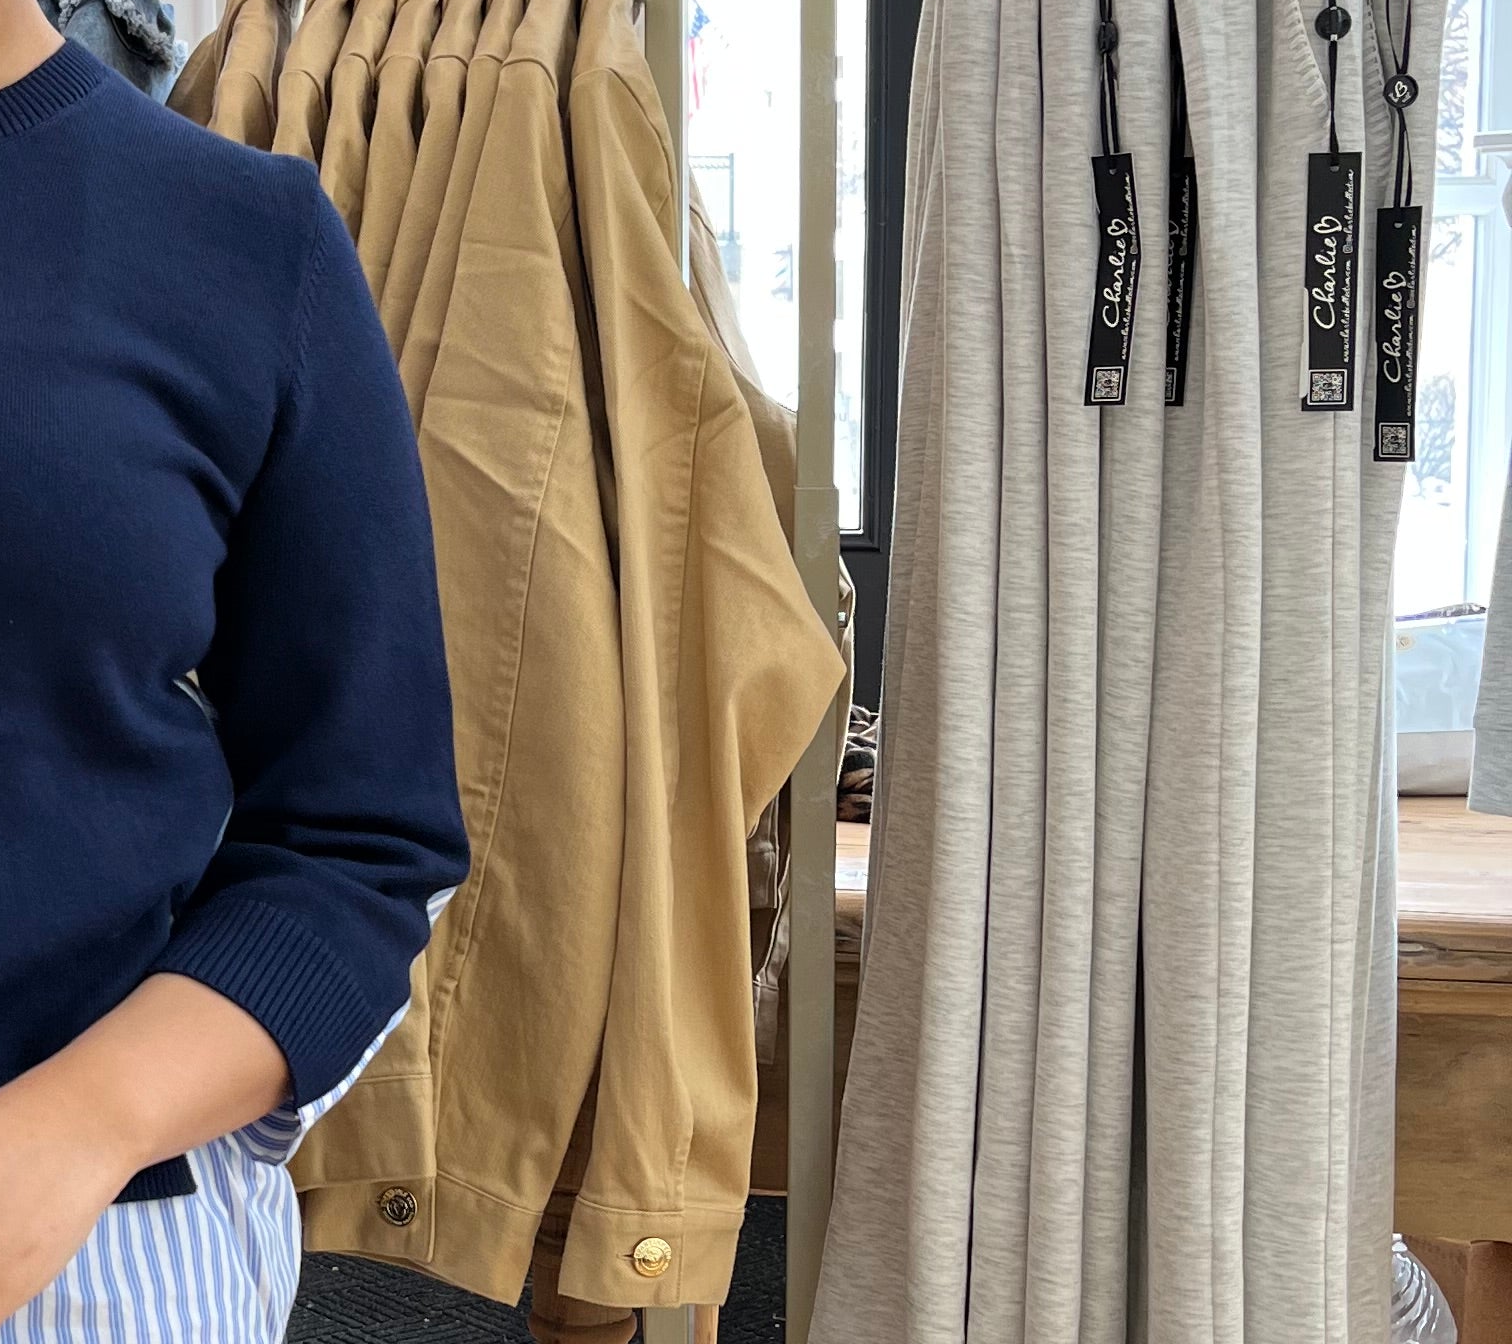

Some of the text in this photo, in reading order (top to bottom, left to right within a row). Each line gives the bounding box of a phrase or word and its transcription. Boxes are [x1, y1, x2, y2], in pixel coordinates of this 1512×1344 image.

[1103, 237, 1125, 329] Charlie
[1312, 236, 1336, 330] Charlie
[1382, 291, 1403, 383] Charlie
